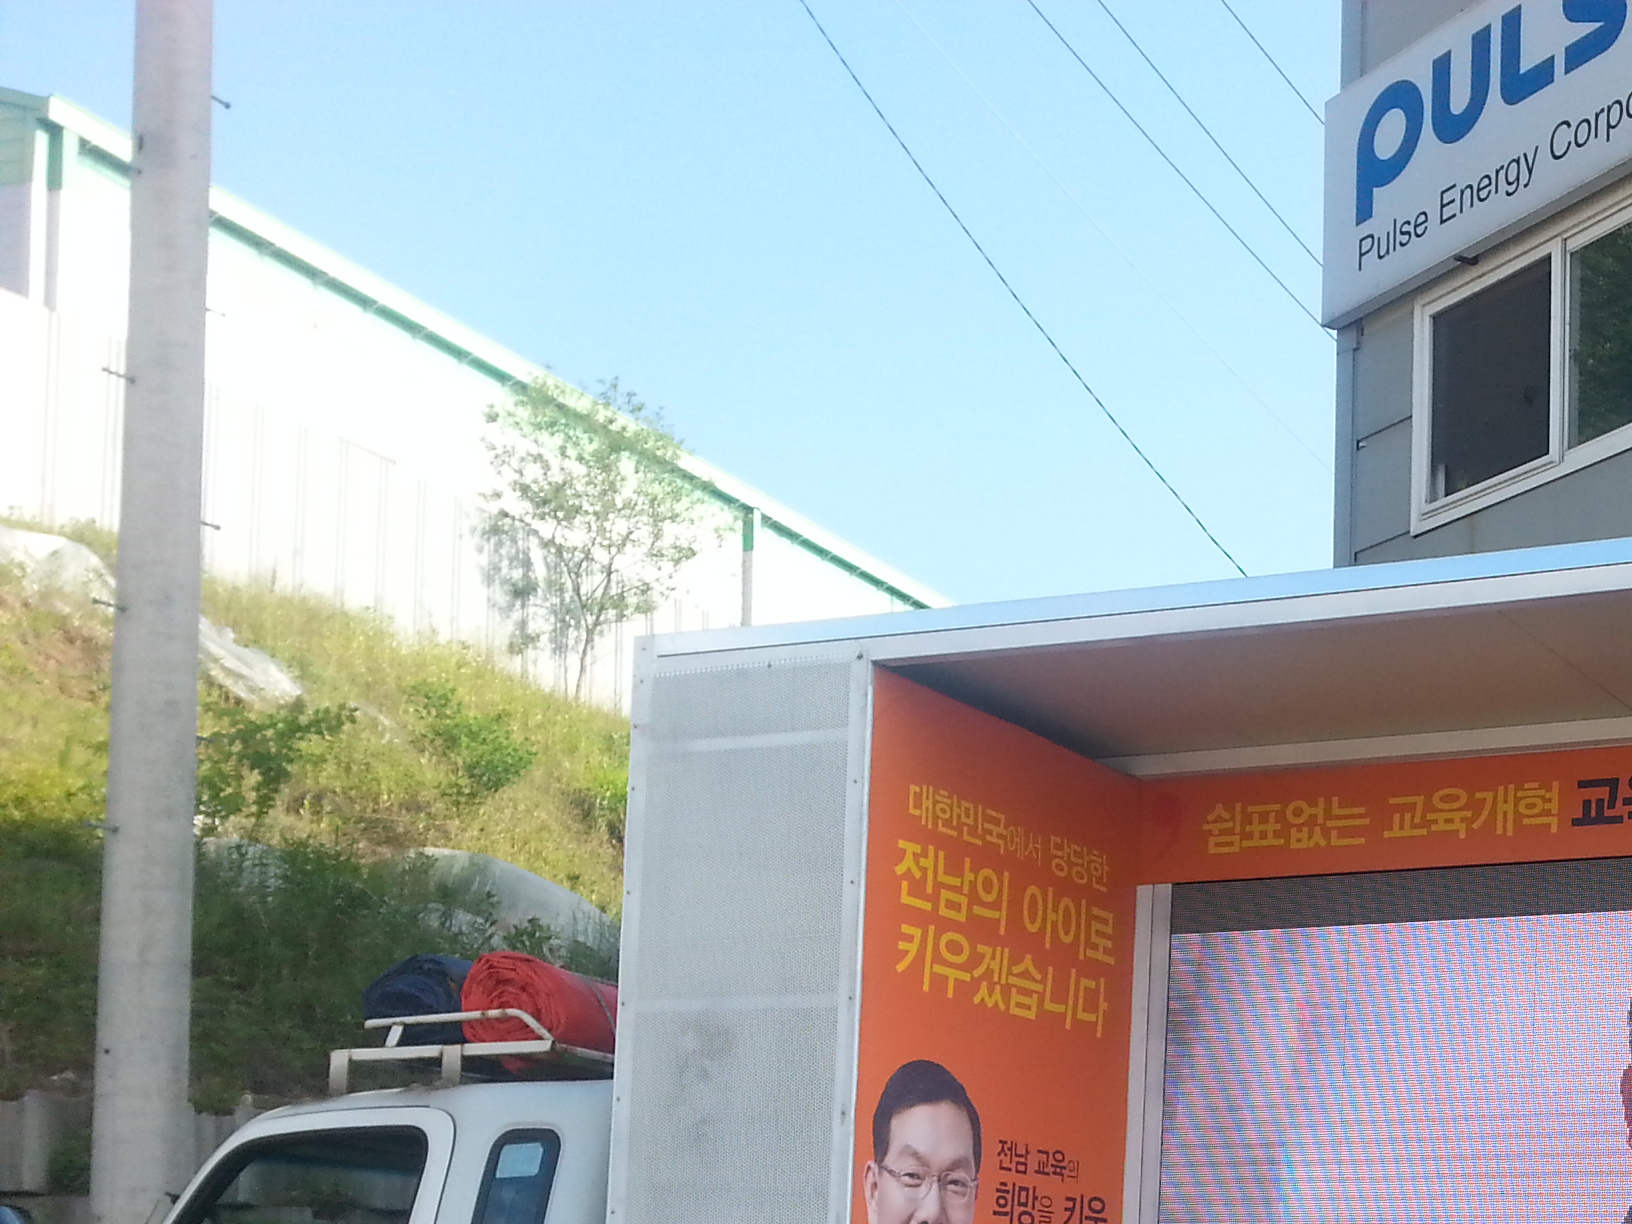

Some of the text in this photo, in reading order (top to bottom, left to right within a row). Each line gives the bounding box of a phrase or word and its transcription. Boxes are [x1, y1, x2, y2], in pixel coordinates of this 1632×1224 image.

[1358, 208, 1428, 271] Pulse
[1440, 145, 1539, 226] Energy
[908, 784, 1109, 892] 대한민국에서 당당한
[1202, 797, 1371, 855] 쉼표없는
[1382, 780, 1560, 839] 교육개혁
[894, 839, 1115, 965] 전남의 아이로
[895, 924, 1108, 1038] 키우겠습니다
